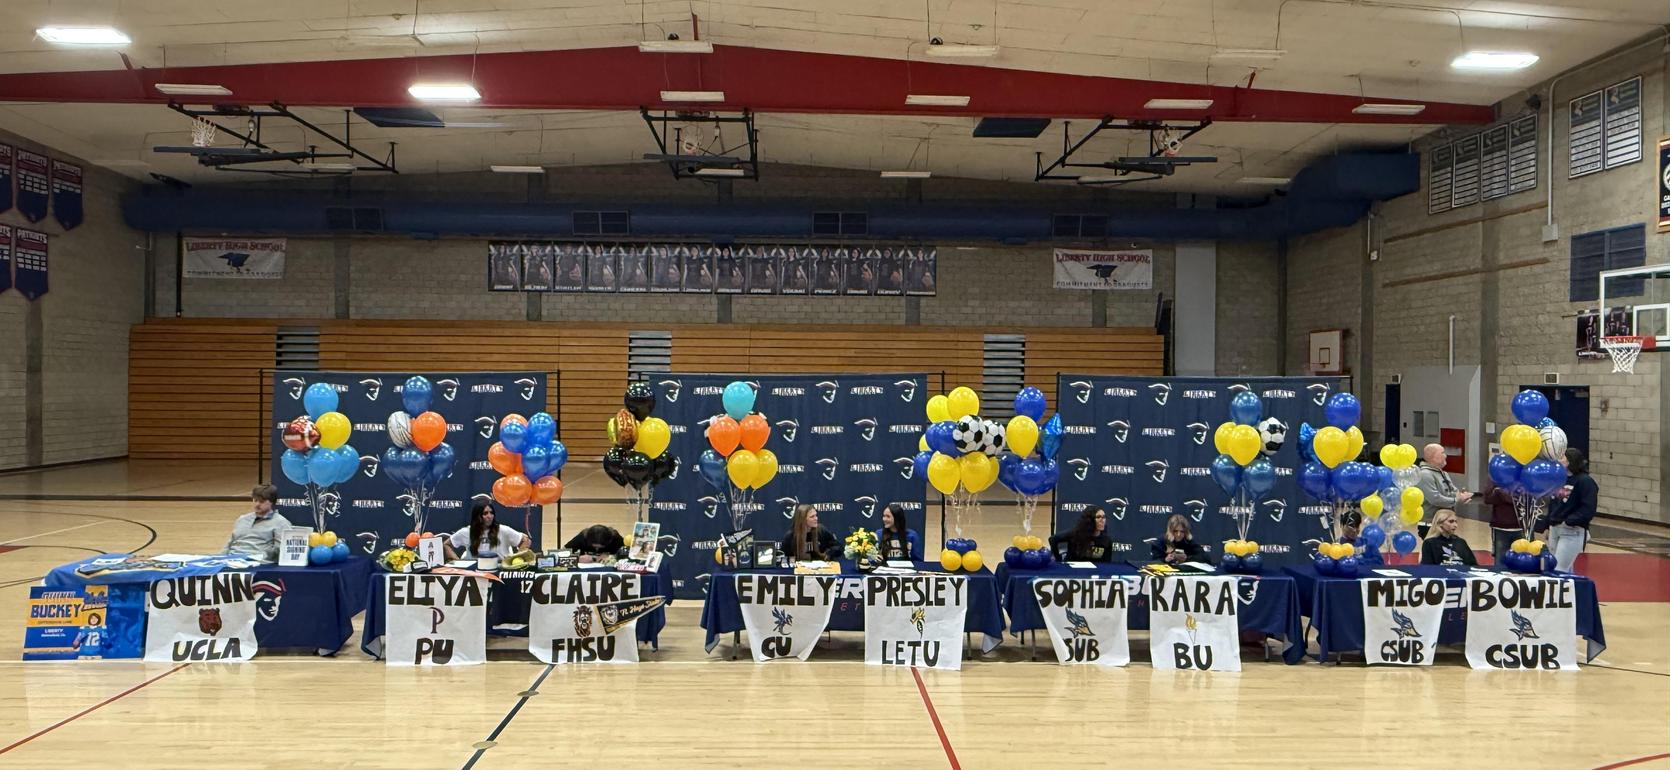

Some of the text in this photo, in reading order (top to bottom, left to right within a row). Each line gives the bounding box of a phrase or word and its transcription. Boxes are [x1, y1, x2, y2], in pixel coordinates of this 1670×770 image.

[150, 572, 255, 609] QUINN
[388, 575, 483, 606] ELIYA
[520, 580, 534, 594] 17
[532, 573, 639, 605] CLAIRE
[737, 575, 837, 606] EMILY
[867, 576, 966, 607] PRESLEY
[1034, 579, 1126, 609] SOPHIA
[1151, 577, 1235, 616] KARA
[1367, 579, 1445, 608] MIGO
[1471, 578, 1573, 612] BOWIE
[31, 604, 81, 618] BUCKEY
[85, 631, 101, 646] 12
[172, 637, 242, 662] UCLA
[414, 637, 454, 665] PU
[552, 635, 616, 663] FHSU
[761, 636, 792, 659] CU
[1380, 640, 1425, 664] CSUB
[881, 640, 940, 667] LETU
[1173, 642, 1213, 671] BU
[1485, 643, 1560, 670] CSUB
